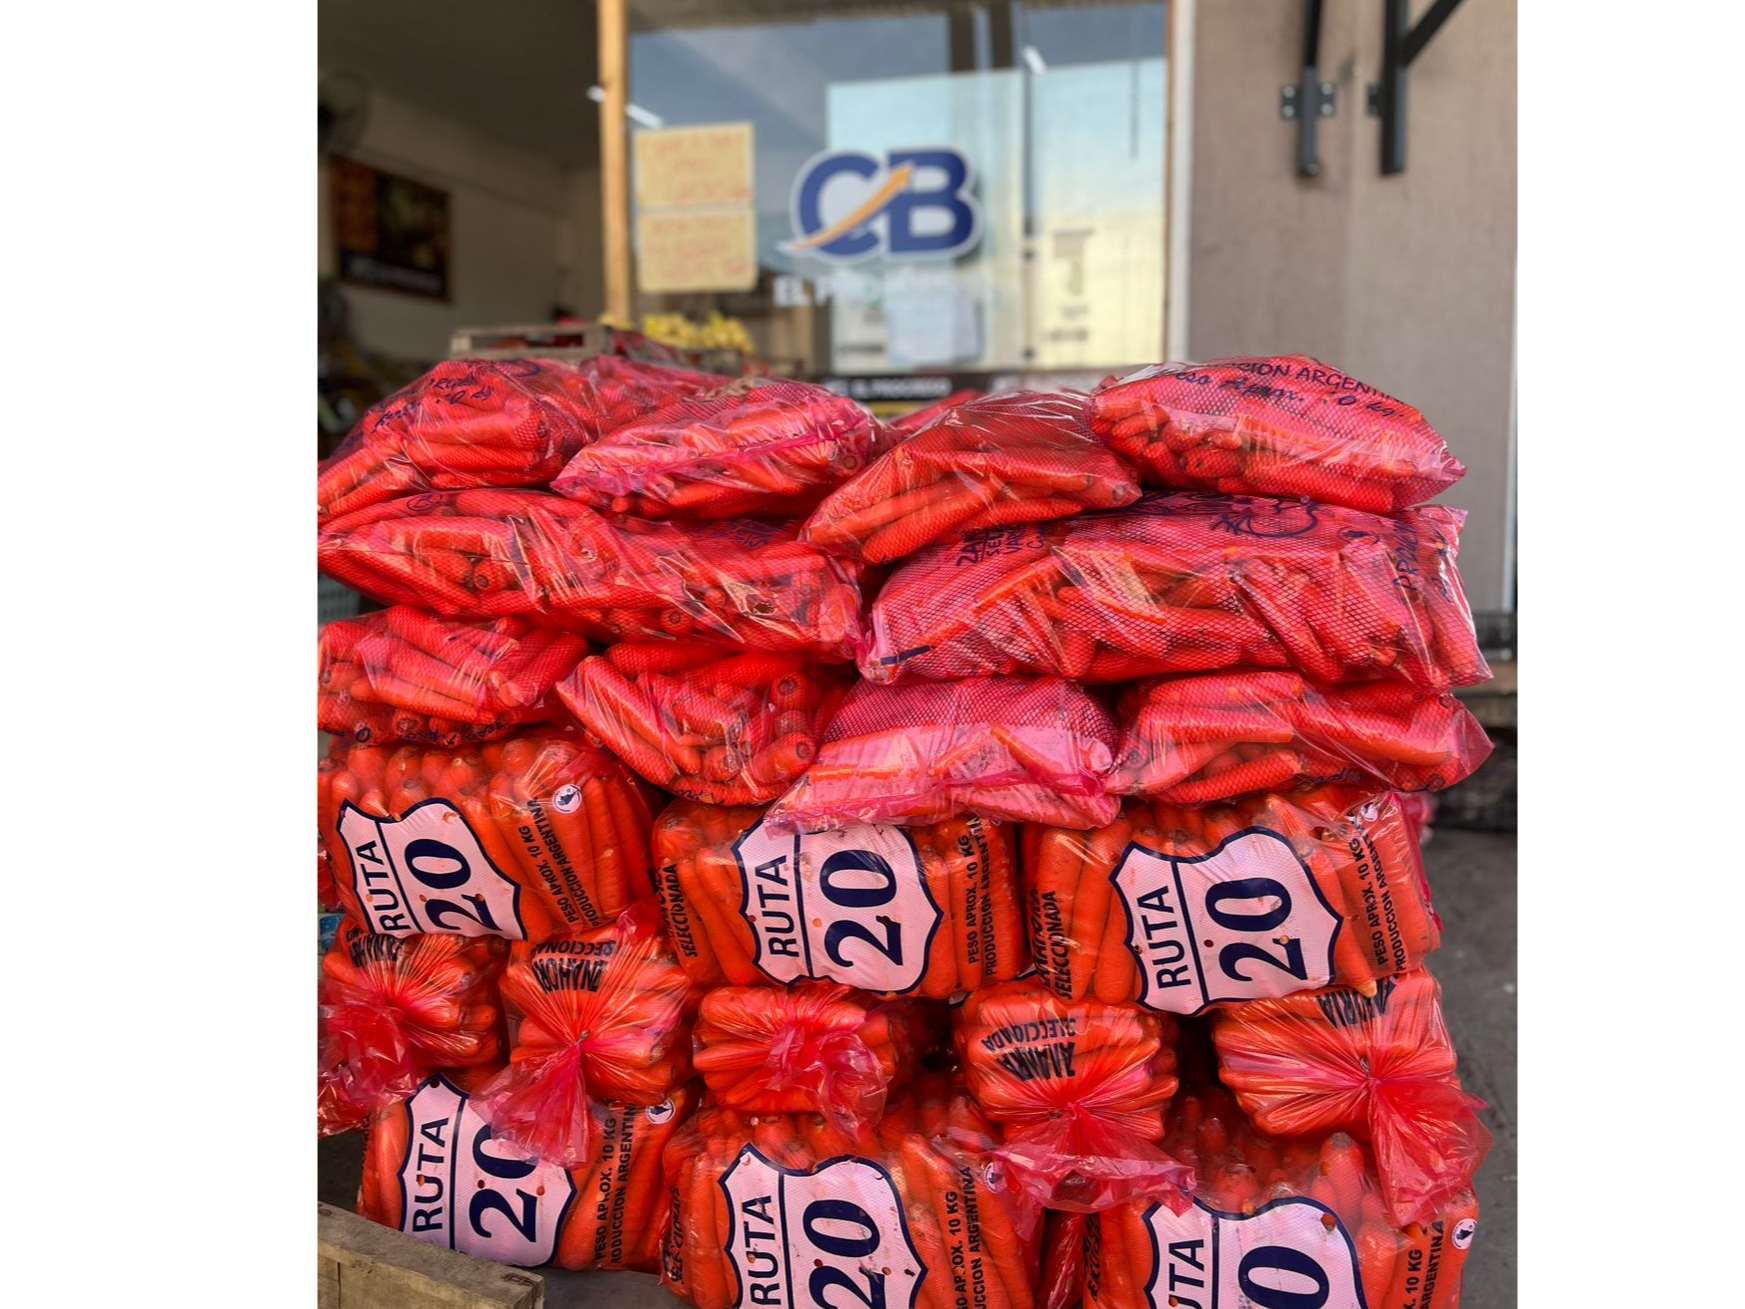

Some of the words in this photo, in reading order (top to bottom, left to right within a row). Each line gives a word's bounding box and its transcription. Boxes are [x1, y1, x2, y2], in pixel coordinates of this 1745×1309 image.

[794, 147, 976, 256] CB
[518, 825, 536, 844] KG
[527, 844, 543, 859] 10
[1348, 837, 1366, 863] KG
[355, 839, 412, 931] RUTA
[404, 838, 503, 932] 20
[536, 859, 565, 896] APROX.
[966, 861, 978, 880] 10
[1357, 863, 1371, 881] 10
[557, 897, 580, 923] PESO
[755, 855, 799, 958] RUTA
[819, 848, 904, 968] 20
[965, 885, 978, 928] APROX.
[1362, 882, 1381, 928] APROX.
[968, 931, 981, 965] PESO
[980, 894, 997, 977] PRODUCCION
[1041, 890, 1073, 999] SELECCIONADA
[1137, 884, 1192, 990] RUTA
[1204, 877, 1308, 981] 20
[1371, 930, 1389, 966] PESO
[1381, 890, 1407, 973] PRODUCCION
[604, 1117, 618, 1141] KG
[412, 1117, 450, 1232] RUTA
[603, 1143, 616, 1162] 10
[469, 1123, 541, 1243] 20
[945, 1191, 959, 1214] KG
[948, 1219, 961, 1236] 10
[960, 1166, 981, 1253] ARGENTINA
[742, 1195, 781, 1305] RUTA
[803, 1199, 881, 1309] 20
[1407, 1249, 1422, 1272] KG
[1238, 1245, 1329, 1309] 0
[1405, 1276, 1420, 1294] 10
